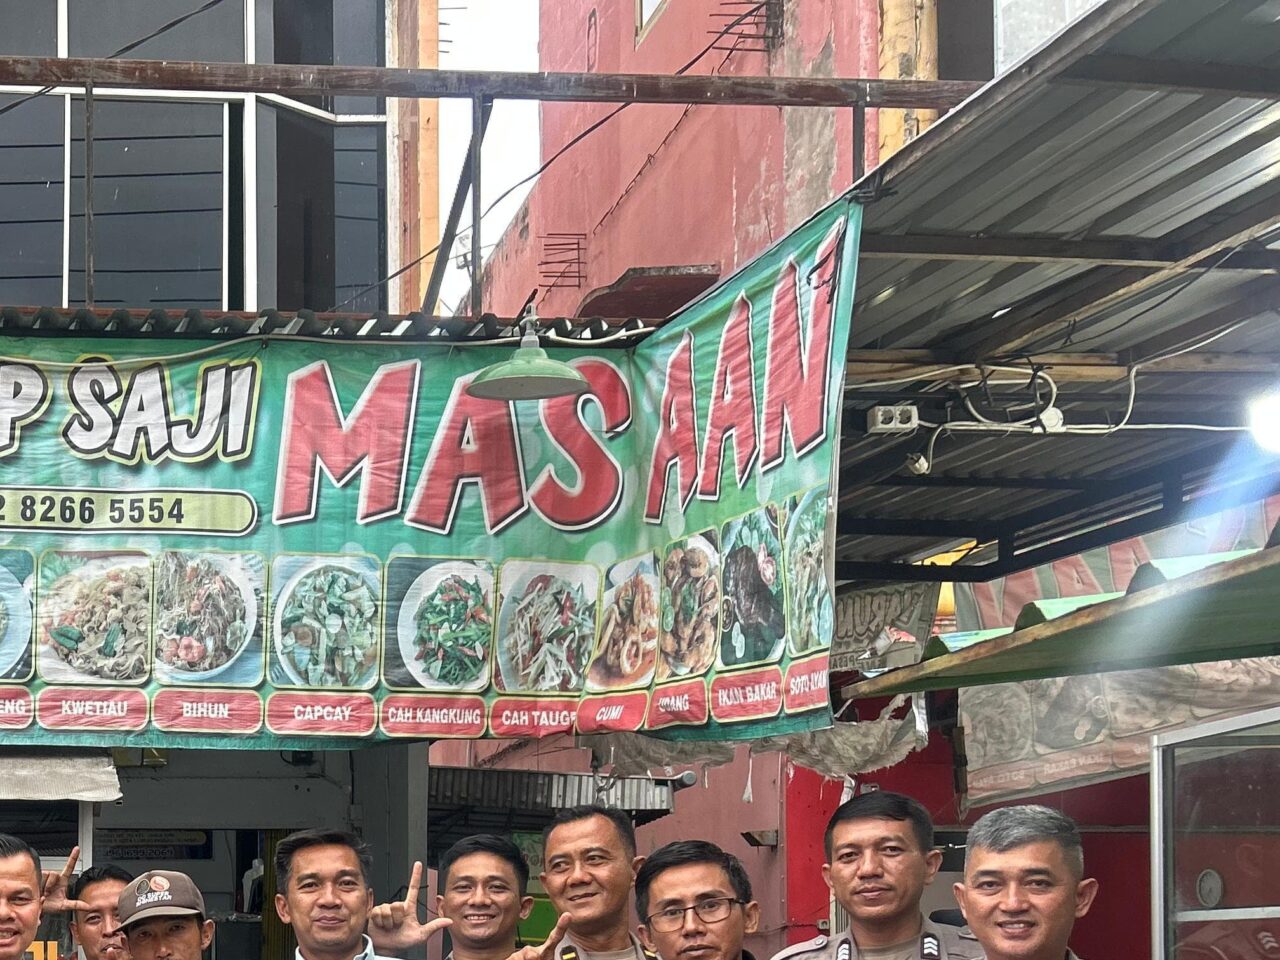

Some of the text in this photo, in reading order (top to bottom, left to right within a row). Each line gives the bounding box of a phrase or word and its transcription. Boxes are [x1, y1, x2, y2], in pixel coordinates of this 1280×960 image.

[62, 359, 258, 463] SAJI
[19, 497, 95, 523] 8266
[110, 497, 184, 526] 5554
[718, 681, 778, 707] IKAN BAKAR
[61, 700, 127, 716] KWETIAU
[182, 702, 229, 718] BIHUN
[294, 704, 352, 721] CAPCAY
[388, 707, 481, 724] CAH KANGKUNG
[596, 705, 624, 722] CUMI
[502, 710, 528, 727] CAH
